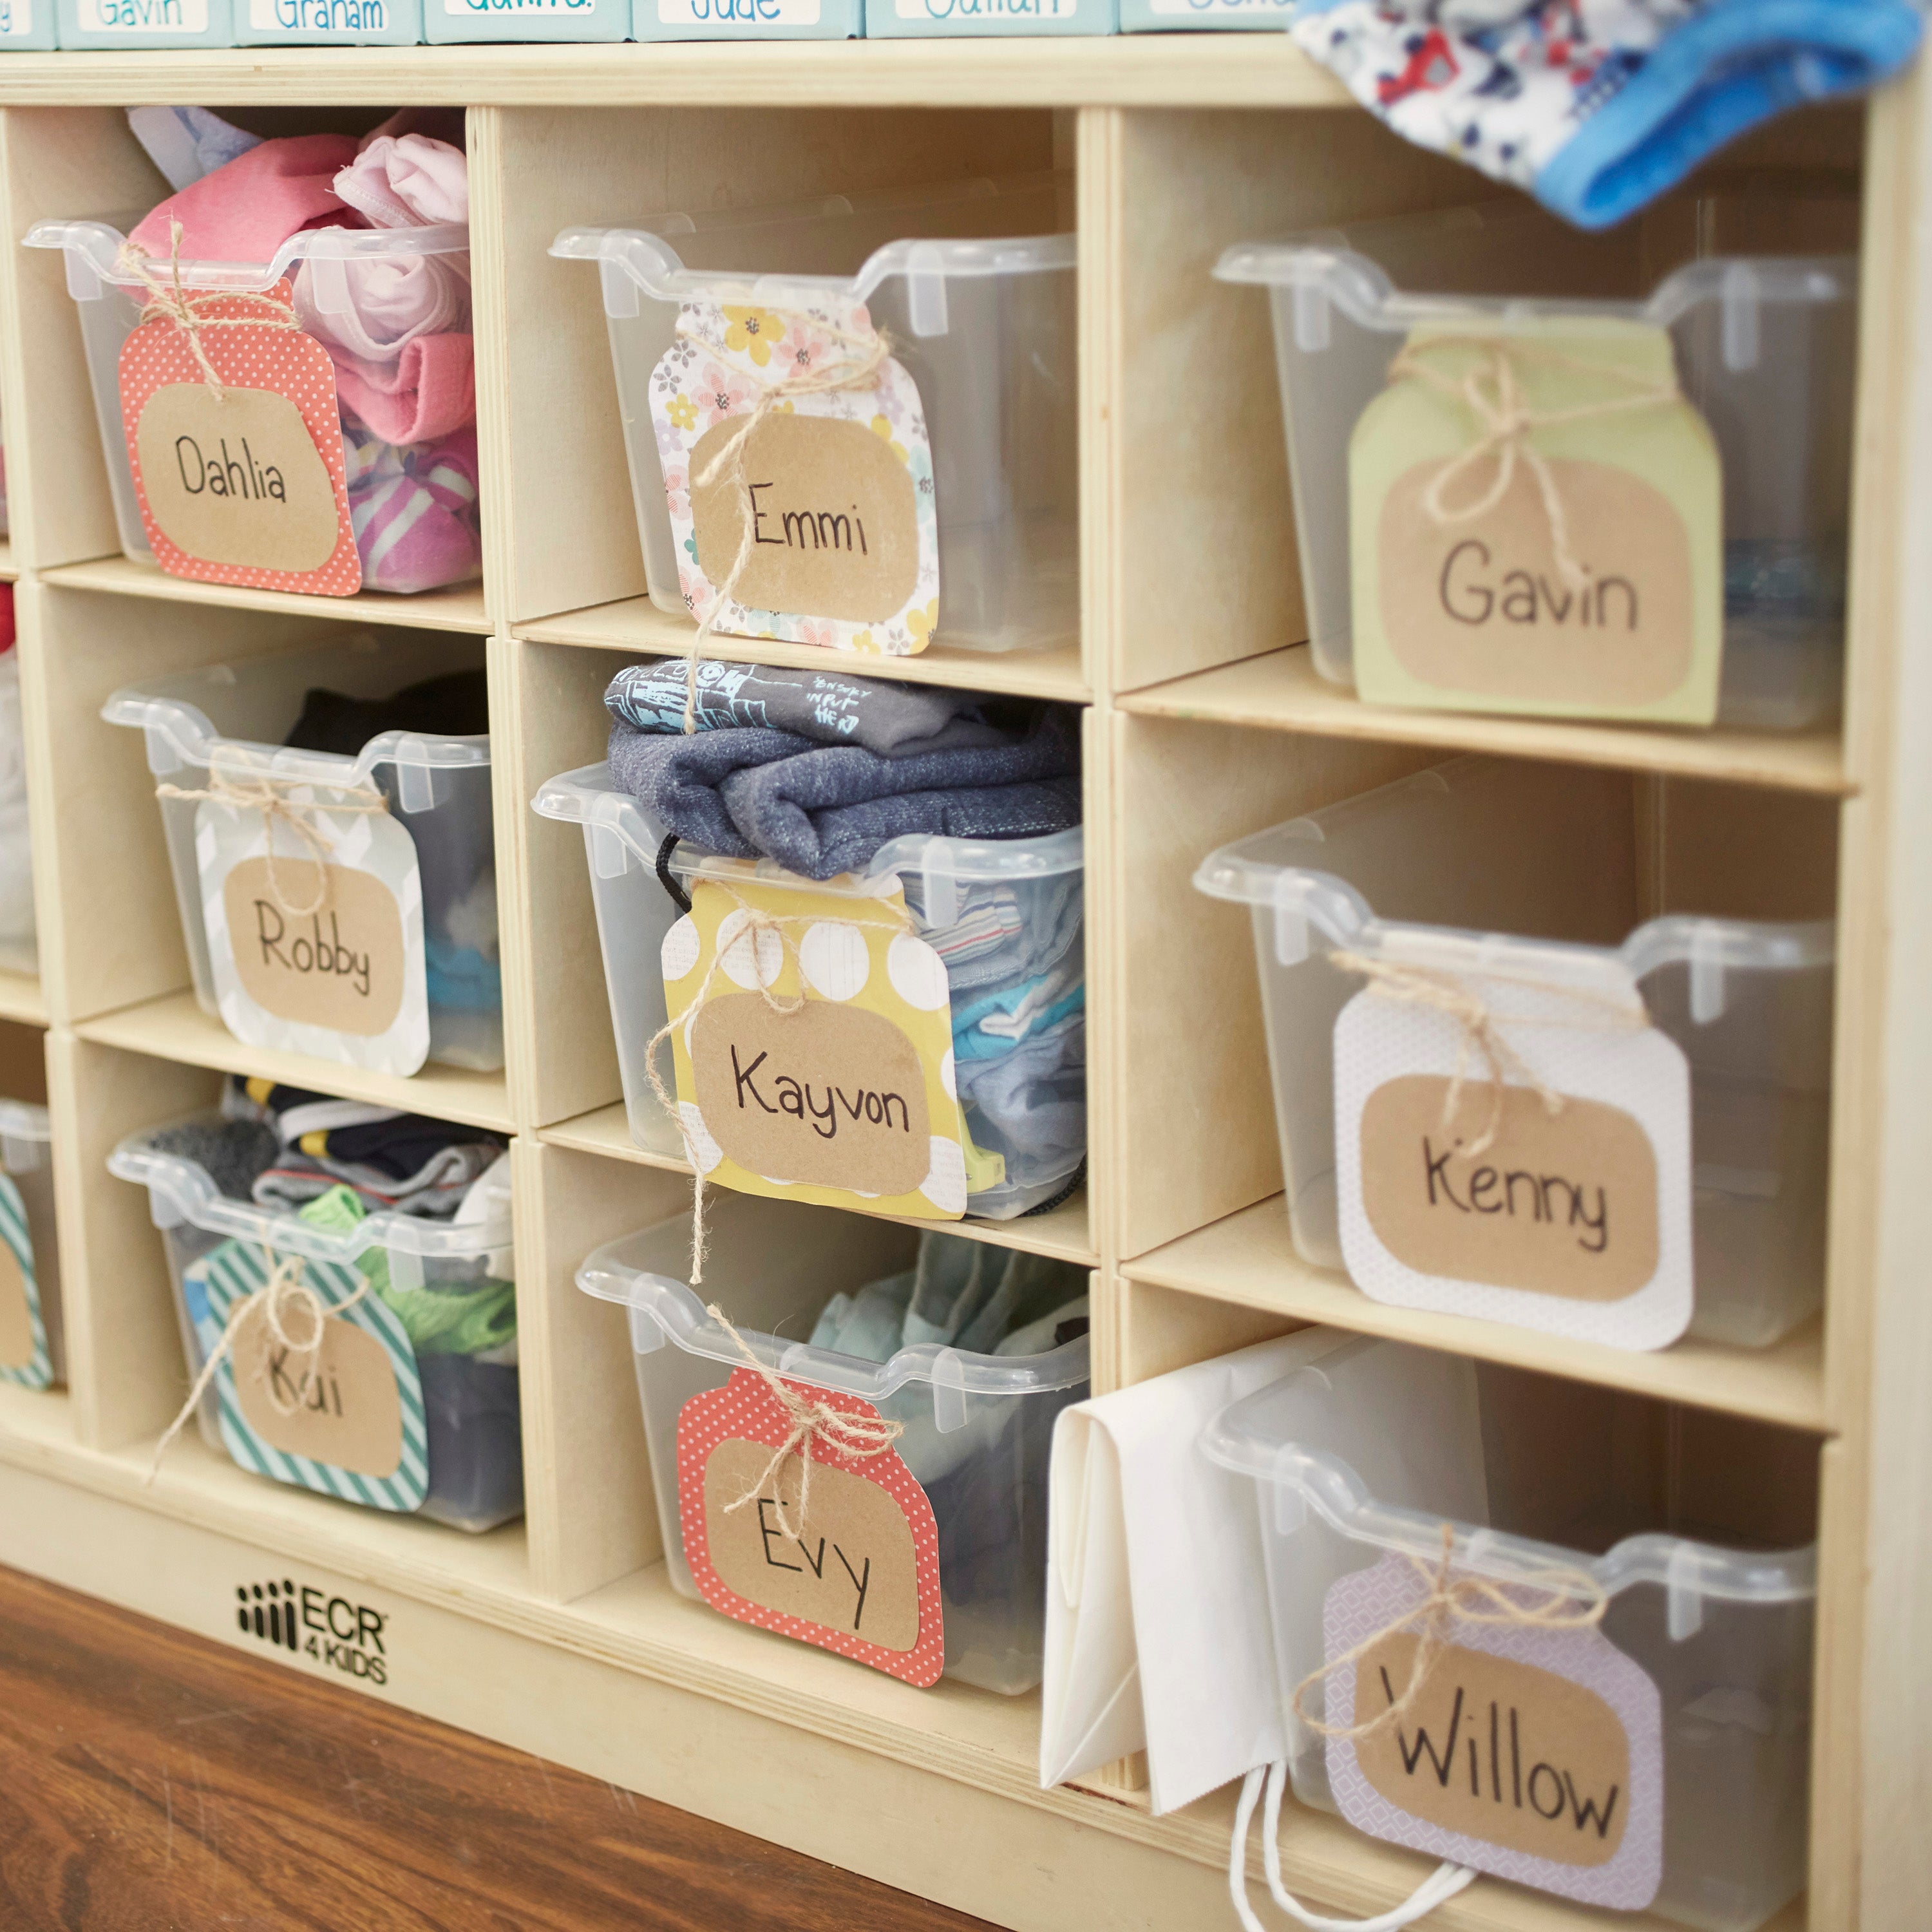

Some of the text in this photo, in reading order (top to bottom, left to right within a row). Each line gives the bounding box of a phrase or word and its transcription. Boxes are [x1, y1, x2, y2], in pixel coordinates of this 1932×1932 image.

[175, 435, 286, 503] Dahlia
[748, 482, 867, 555] Emmi
[1439, 539, 1639, 632] Gavin
[806, 693, 859, 711] INPUT
[253, 899, 370, 996] Robby
[731, 1044, 909, 1139] Kayvon
[1423, 1135, 1607, 1253] Kenny
[324, 1640, 387, 1685] KIDS
[1379, 1665, 1618, 1839] Willow
